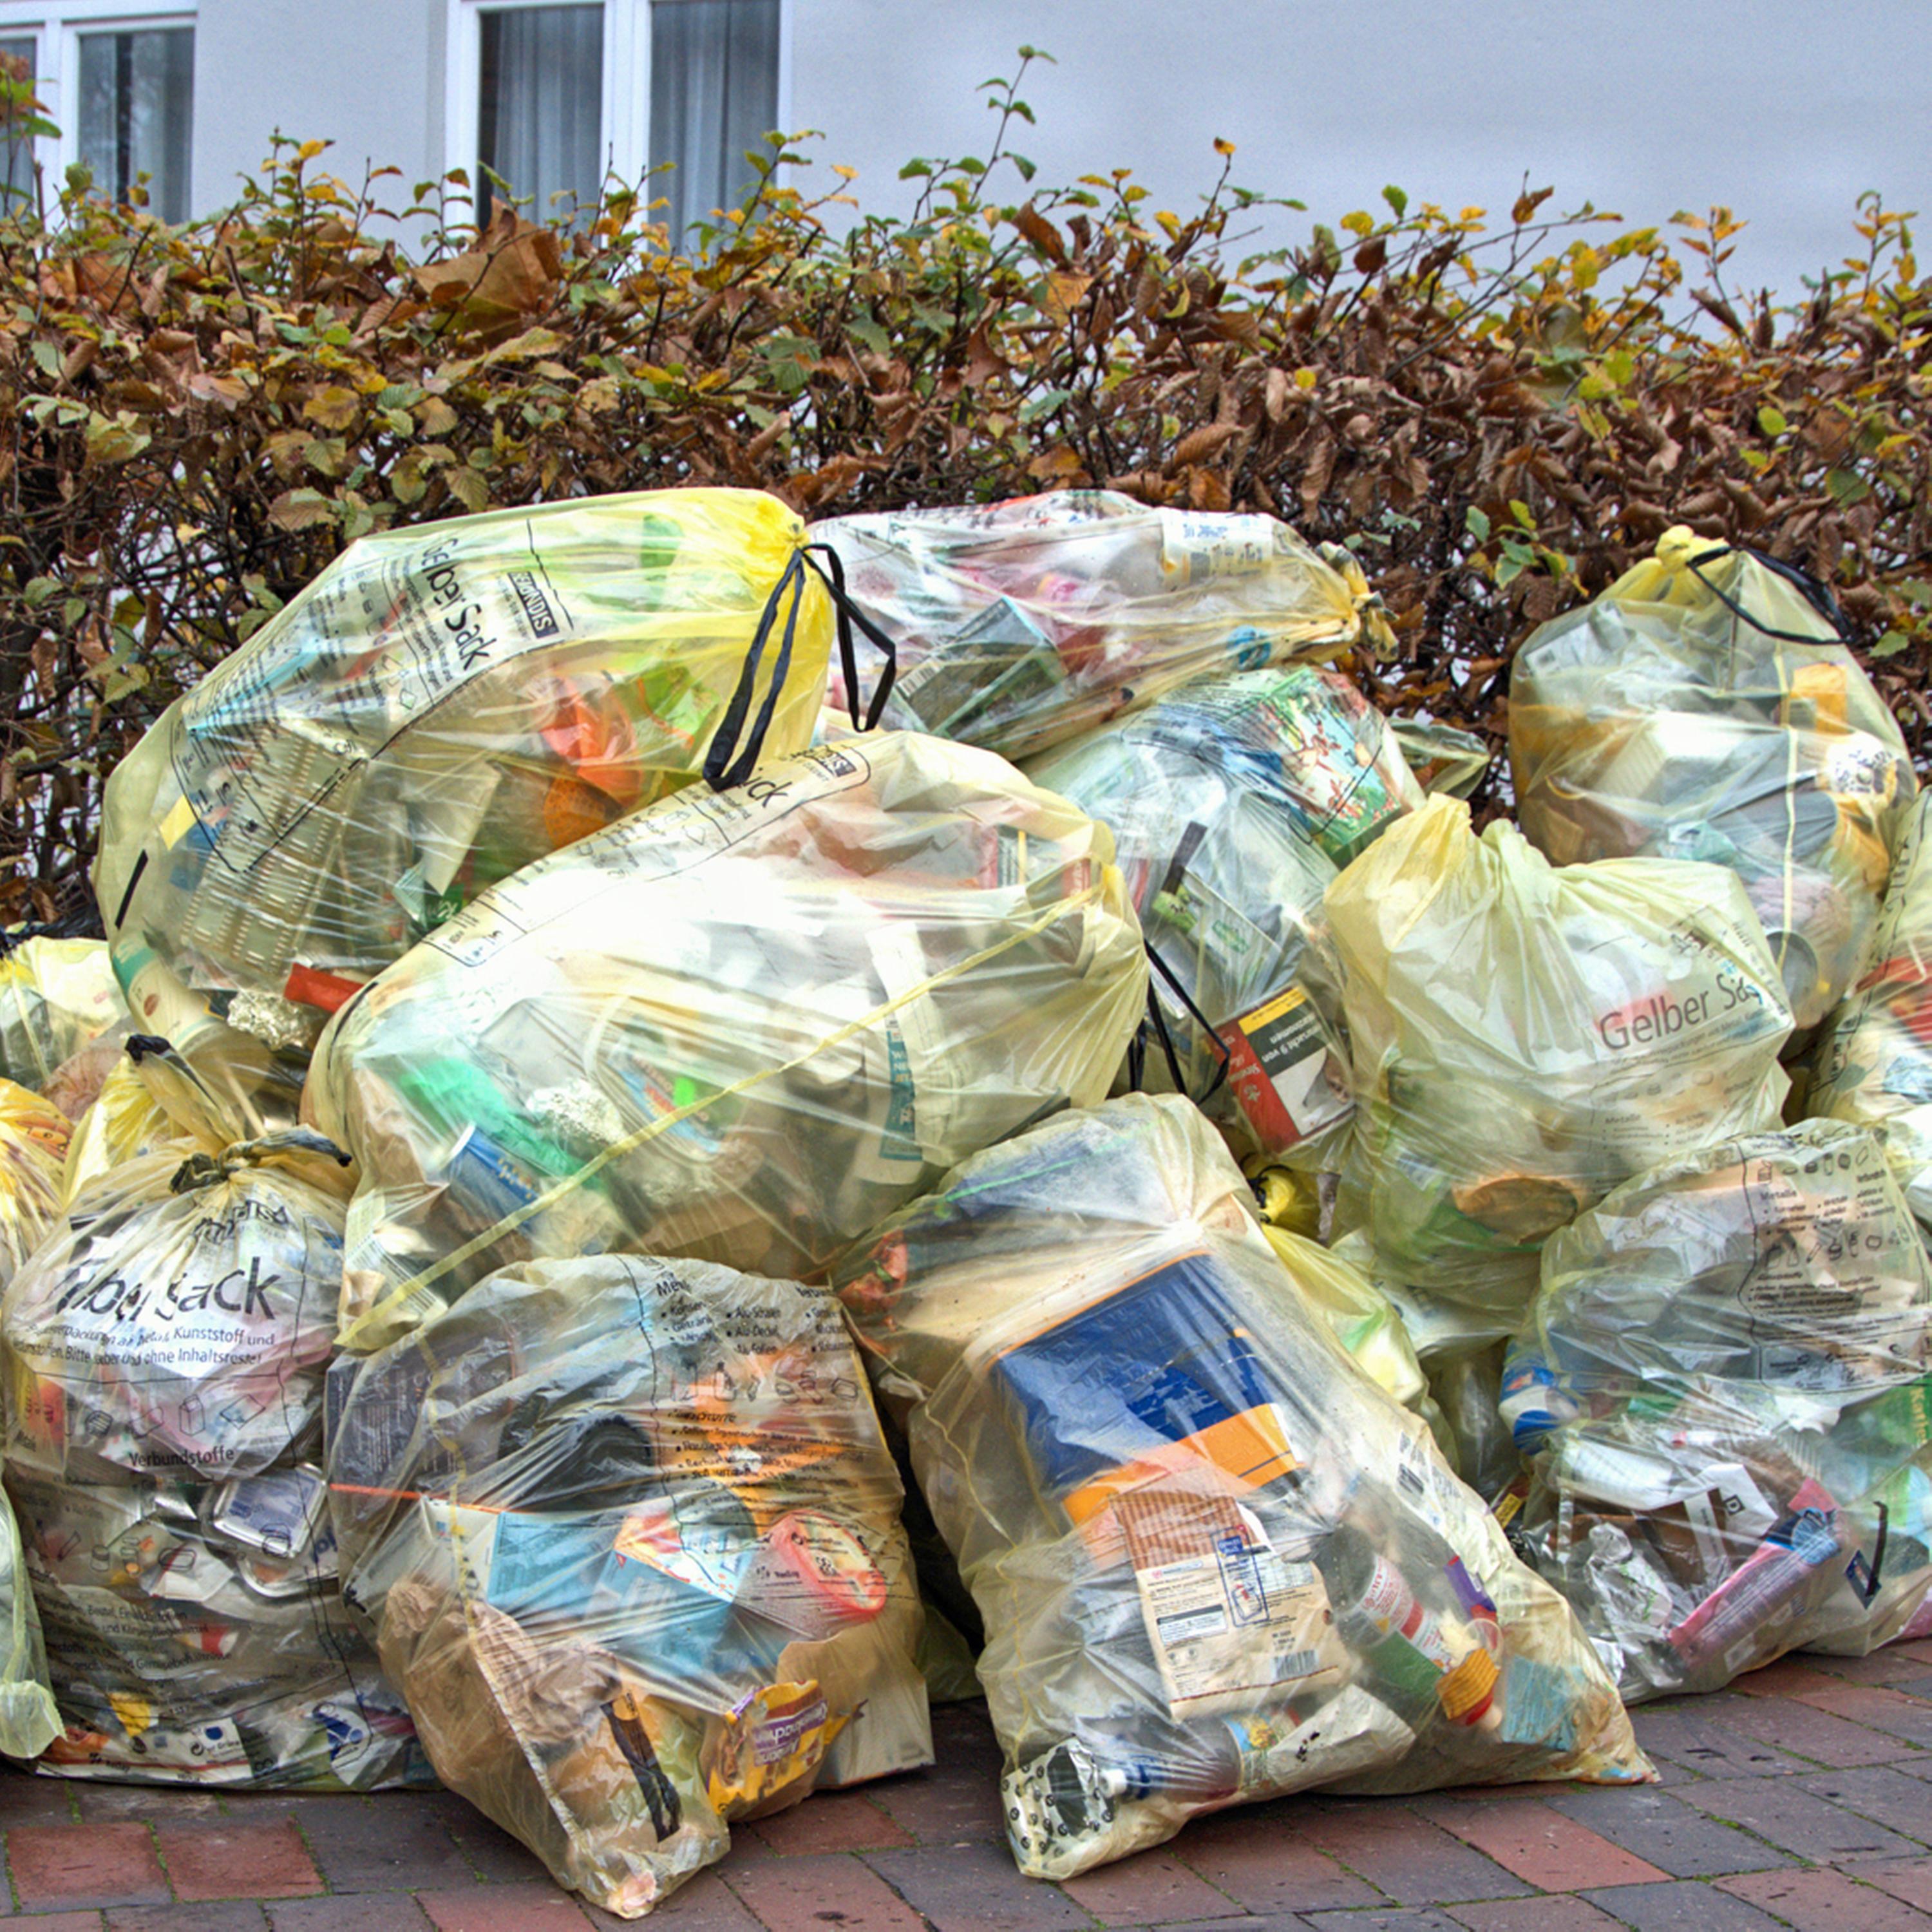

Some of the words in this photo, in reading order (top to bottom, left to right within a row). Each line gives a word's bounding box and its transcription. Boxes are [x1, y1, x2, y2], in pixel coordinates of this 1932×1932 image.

[444, 604, 498, 671] Sack
[1600, 990, 1709, 1050] Gelber
[173, 1326, 245, 1345] Kunststoff
[247, 1333, 275, 1346] und
[66, 1345, 91, 1365] Bitte
[129, 1446, 234, 1467] Verbundstoffe
